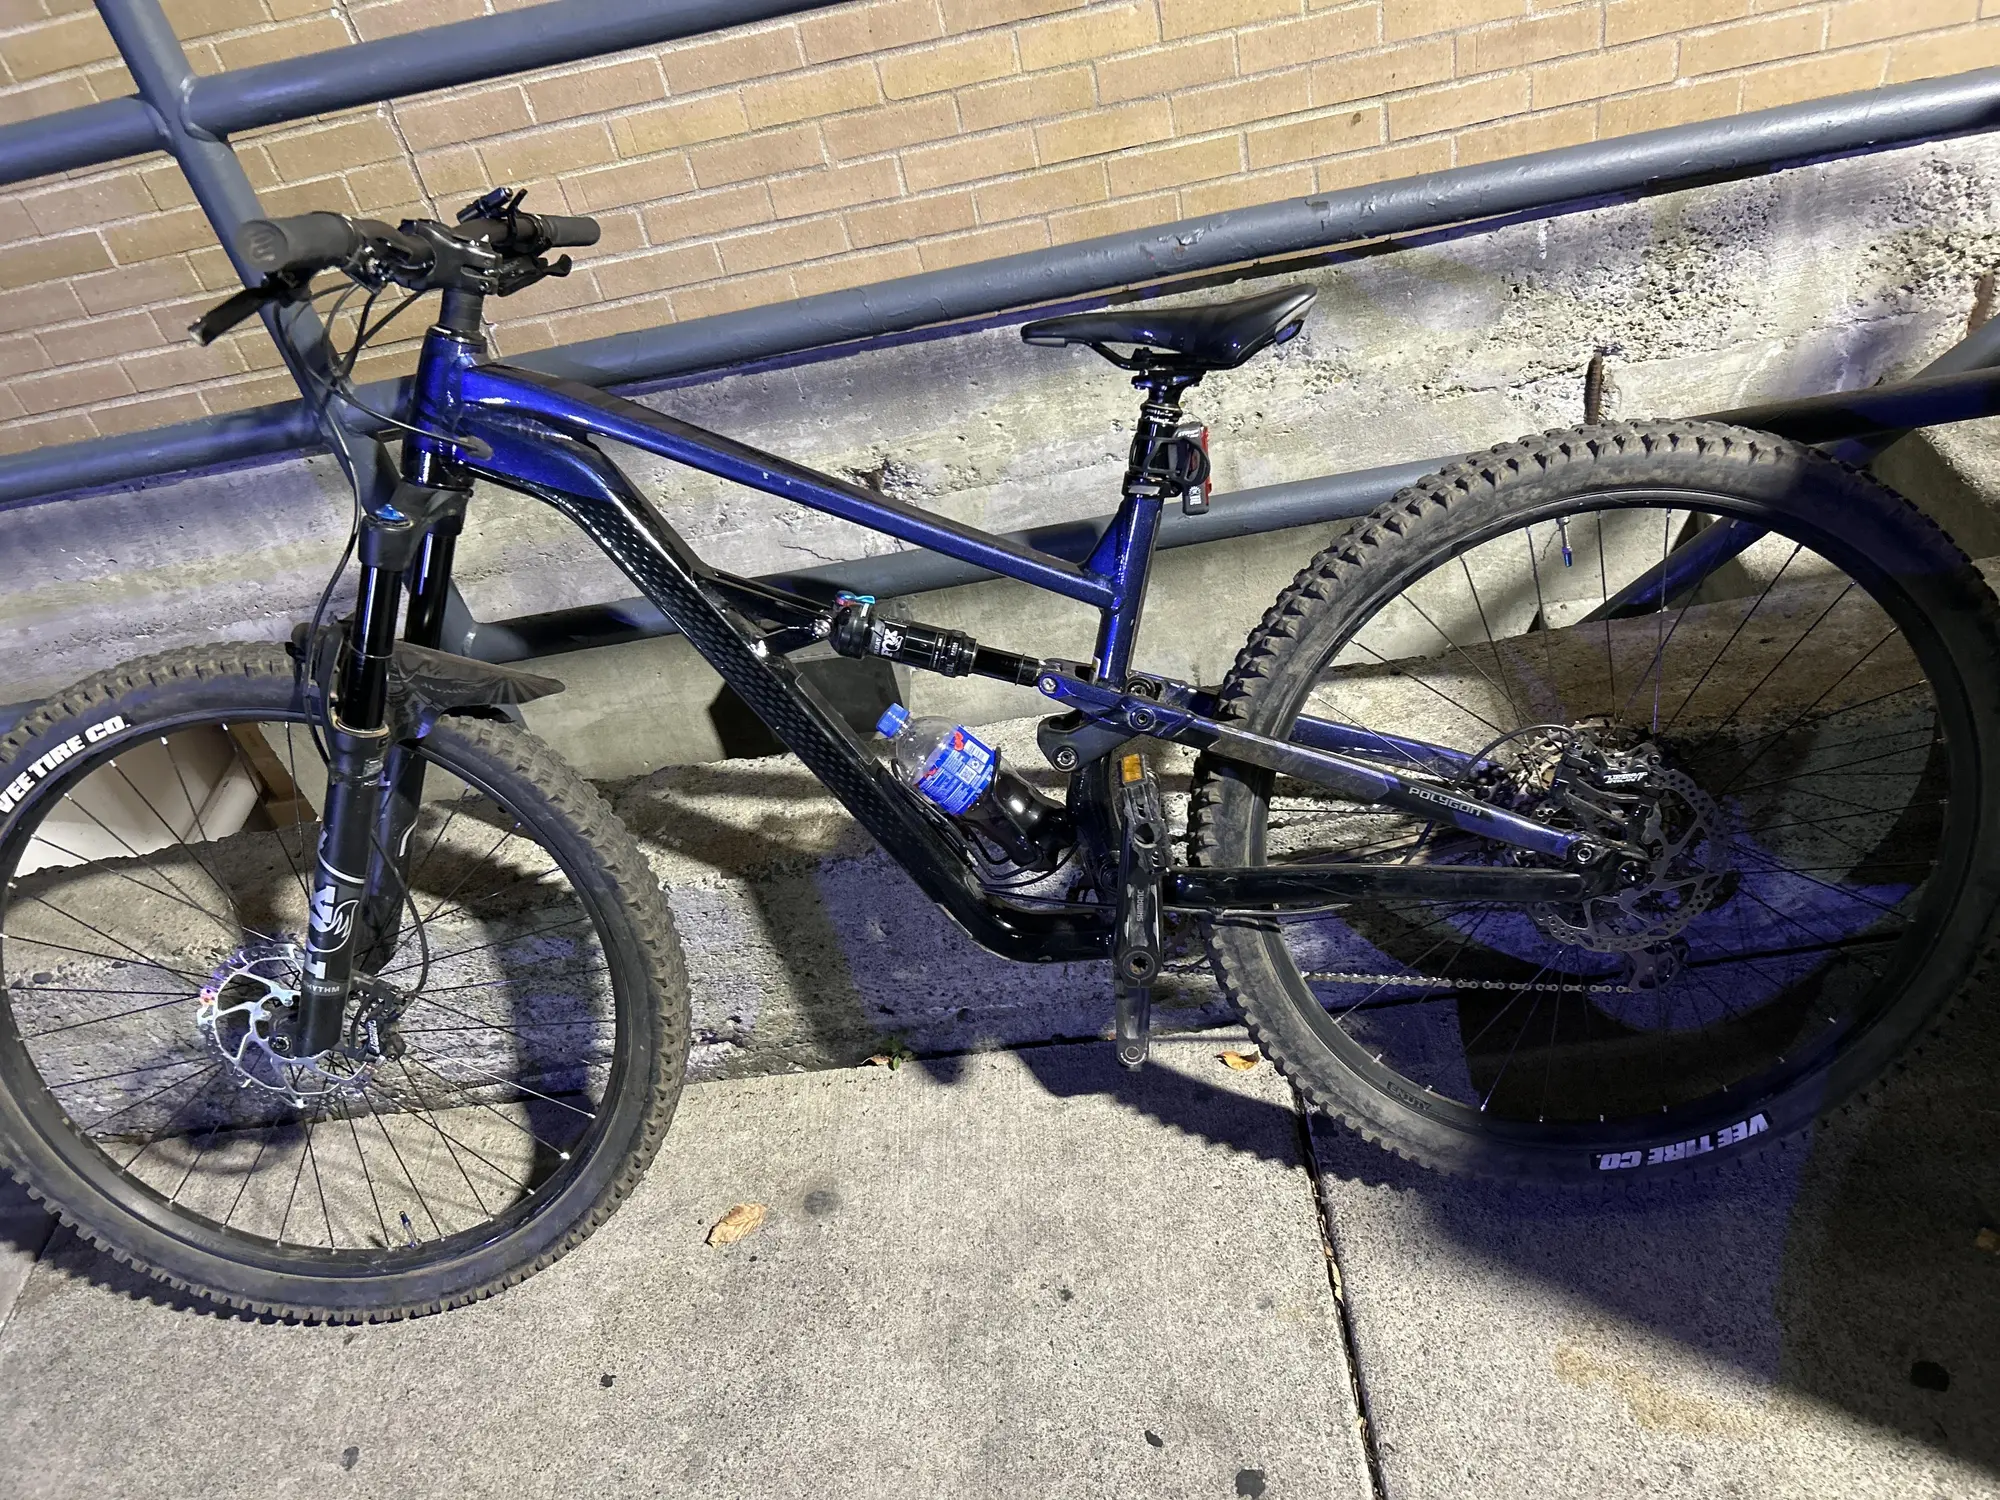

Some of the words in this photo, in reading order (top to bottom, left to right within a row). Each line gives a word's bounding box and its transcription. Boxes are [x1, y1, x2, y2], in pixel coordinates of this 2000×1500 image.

[881, 628, 903, 658] FOX
[0, 771, 36, 813] VEE
[27, 734, 86, 779] TIRE
[84, 715, 132, 743] CO.
[1408, 787, 1481, 816] POLYGON
[1717, 1113, 1769, 1147] VEE
[1597, 1151, 1642, 1170] CO.
[1647, 1135, 1714, 1165] TIRE
